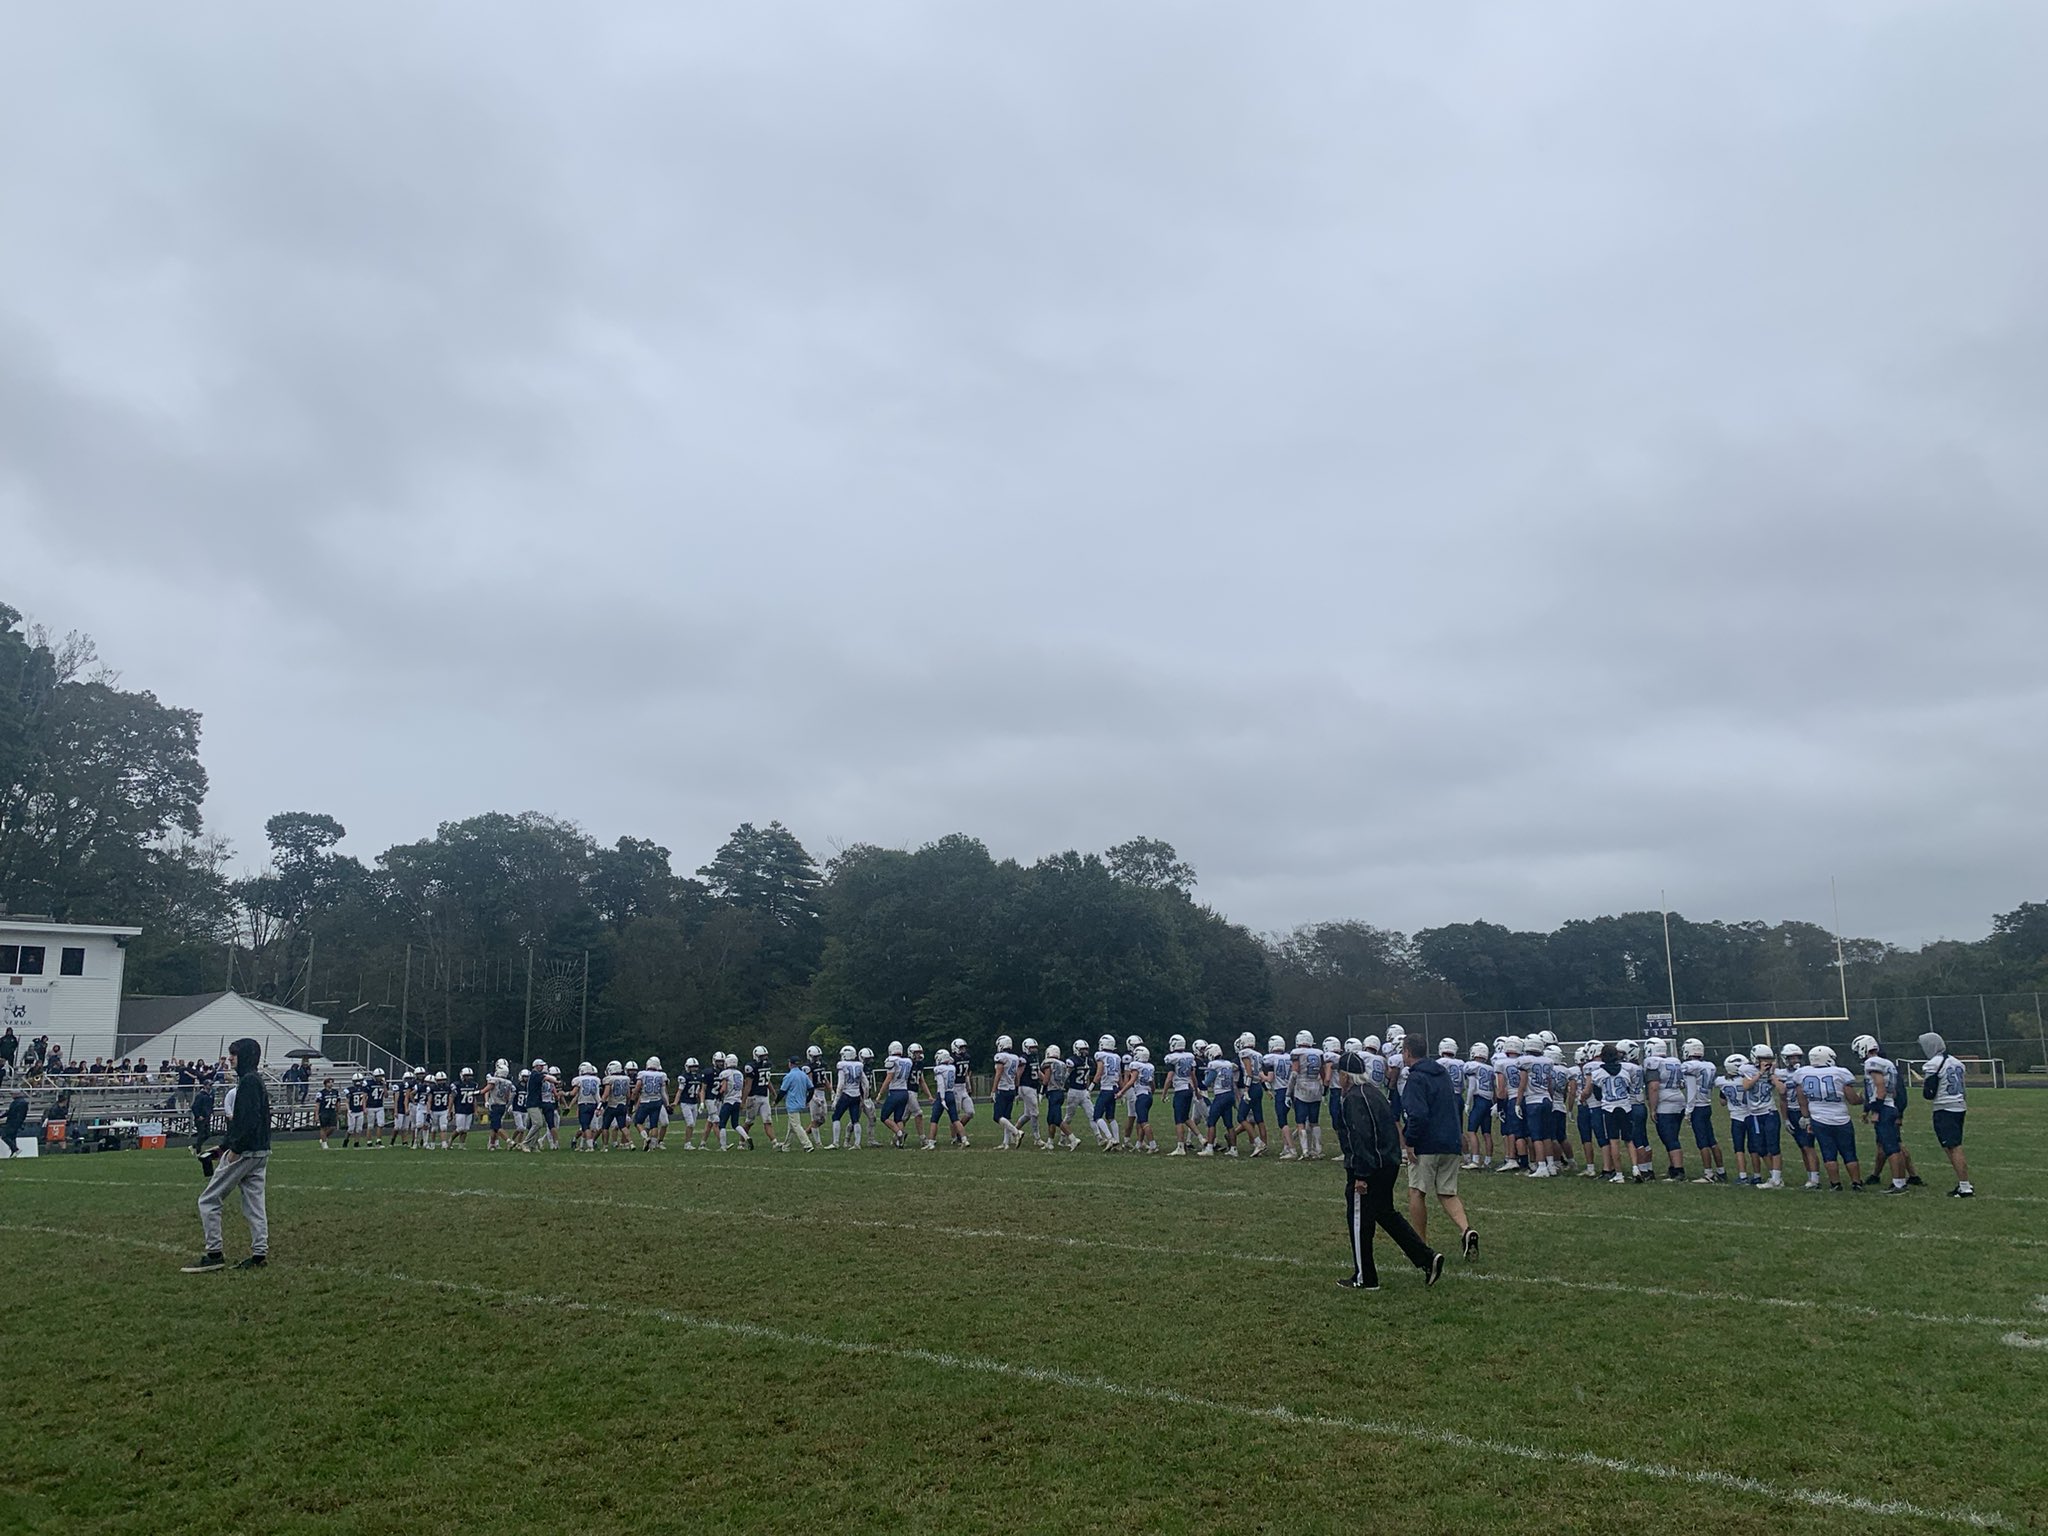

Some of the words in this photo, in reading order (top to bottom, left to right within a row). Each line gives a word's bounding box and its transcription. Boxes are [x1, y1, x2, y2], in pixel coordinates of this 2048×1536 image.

[1307, 1054, 1320, 1075] 2
[372, 1087, 384, 1100] 47
[1603, 1076, 1629, 1102] 12
[1803, 1075, 1841, 1102] 91
[325, 1097, 337, 1109] 79
[434, 1093, 449, 1106] 64
